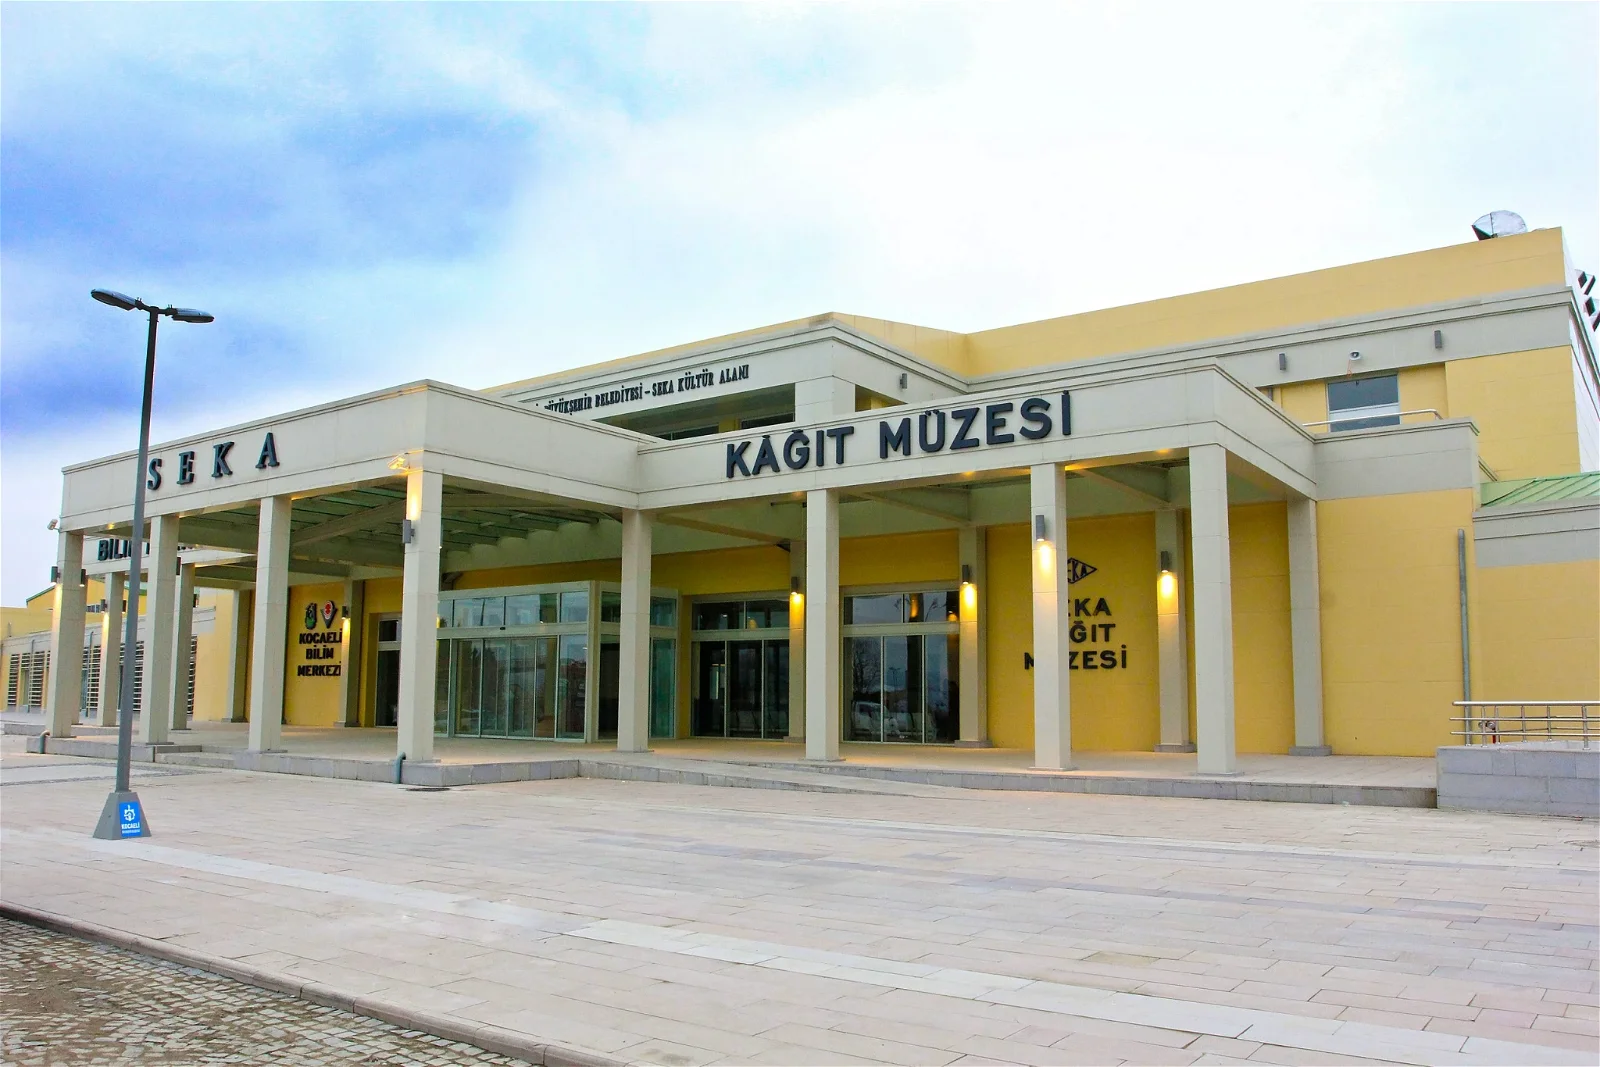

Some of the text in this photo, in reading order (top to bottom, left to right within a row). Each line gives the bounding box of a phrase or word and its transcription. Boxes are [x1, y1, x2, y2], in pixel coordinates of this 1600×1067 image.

[595, 382, 643, 407] BELEDİYESİ
[652, 380, 675, 397] SEKA
[677, 368, 715, 392] KÜLTÜR
[719, 364, 750, 384] ALANI
[879, 389, 1072, 459] MÜZESİ
[147, 432, 280, 491] SEKA
[298, 628, 343, 644] KOCAELİ
[305, 645, 334, 660] BİLİM
[1024, 644, 1127, 670] MZESİ
[297, 661, 342, 677] MERKEZİ
